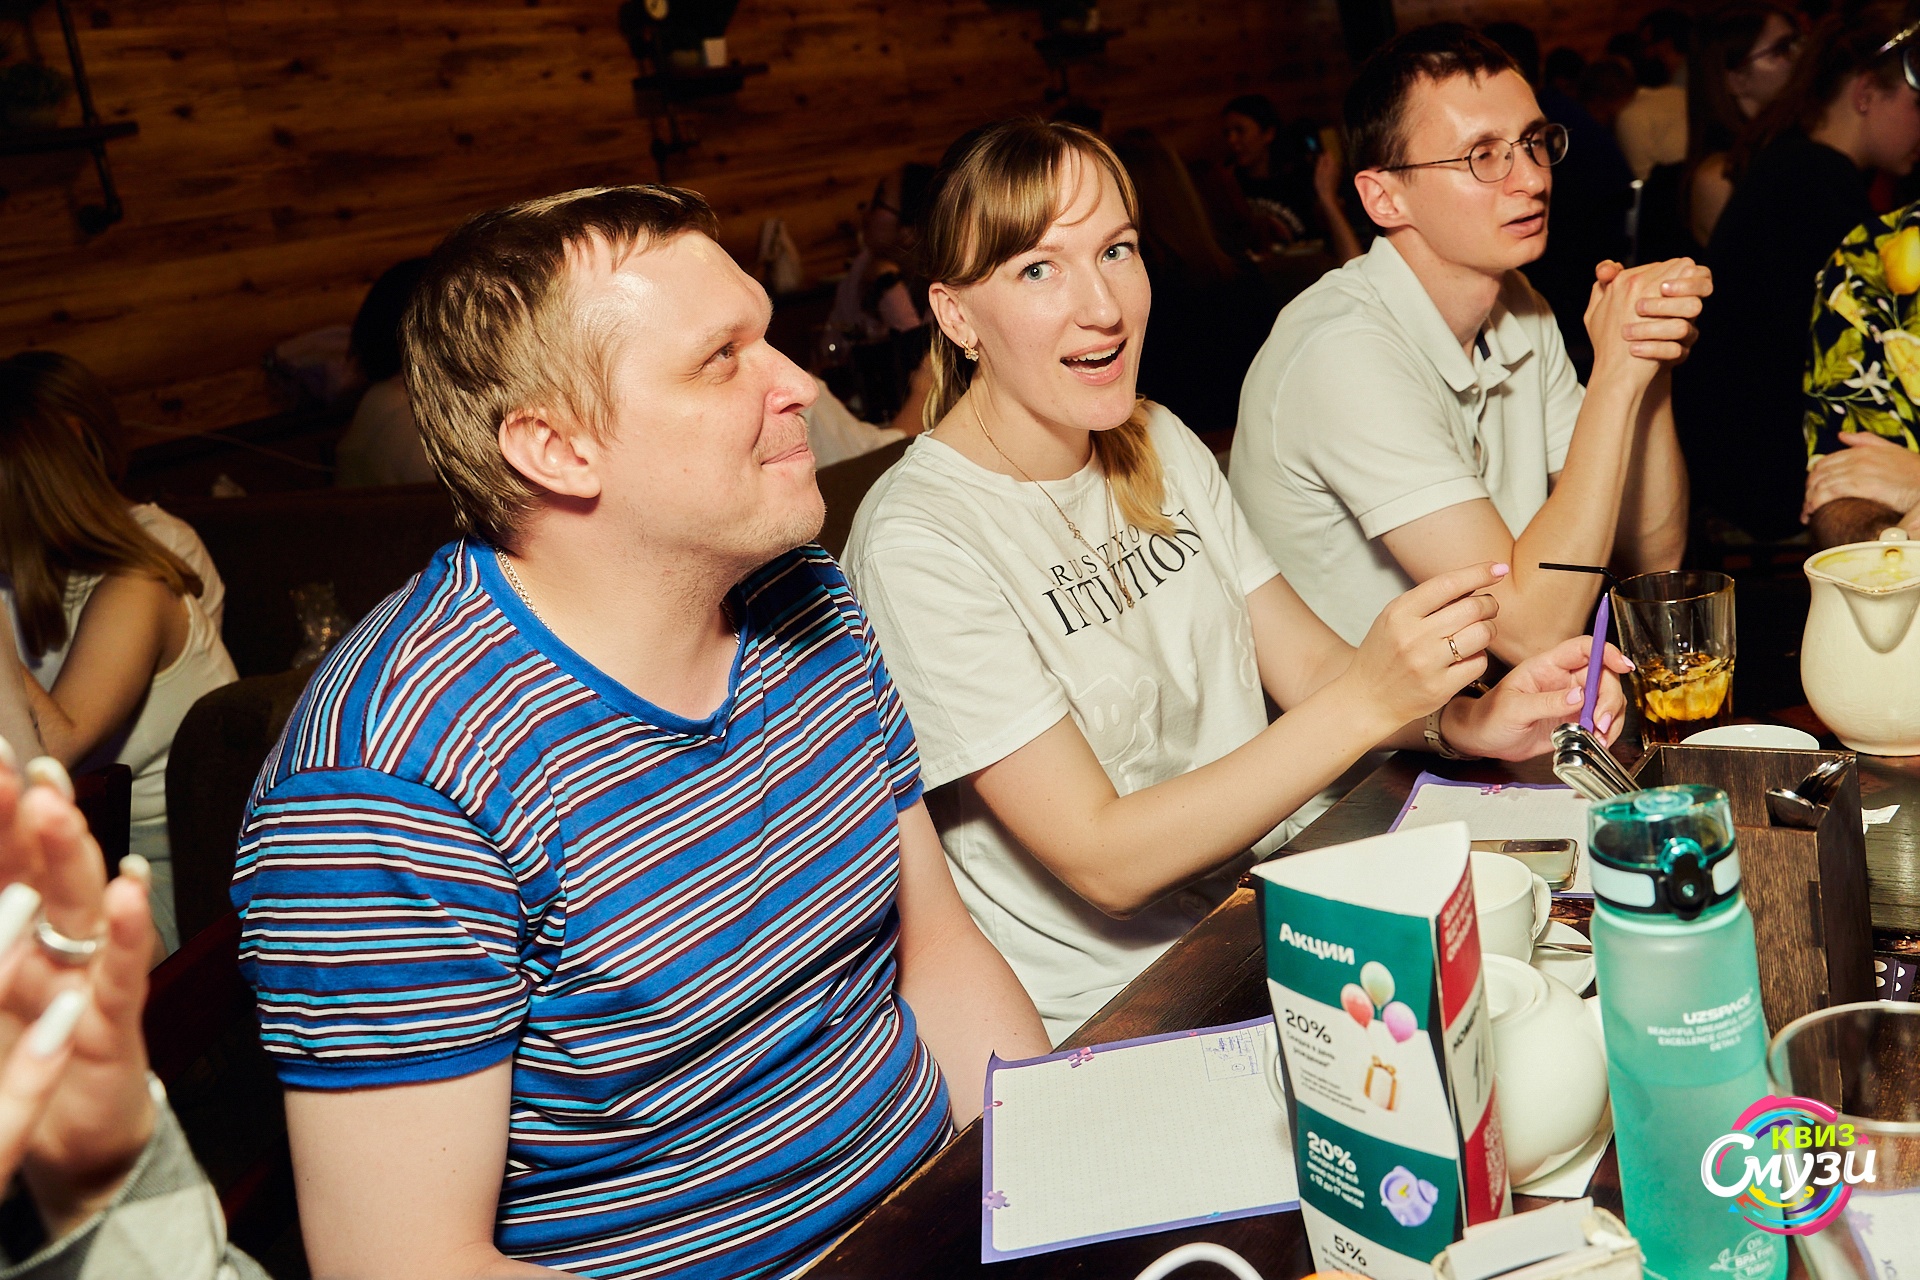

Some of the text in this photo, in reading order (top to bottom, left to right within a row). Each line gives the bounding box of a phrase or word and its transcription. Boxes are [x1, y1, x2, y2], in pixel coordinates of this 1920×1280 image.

[1279, 922, 1356, 966] Акции
[1285, 1008, 1332, 1044] 20%
[1307, 1131, 1357, 1174] 20%
[1333, 1234, 1367, 1267] 5%
[1734, 1252, 1757, 1268] BPA
